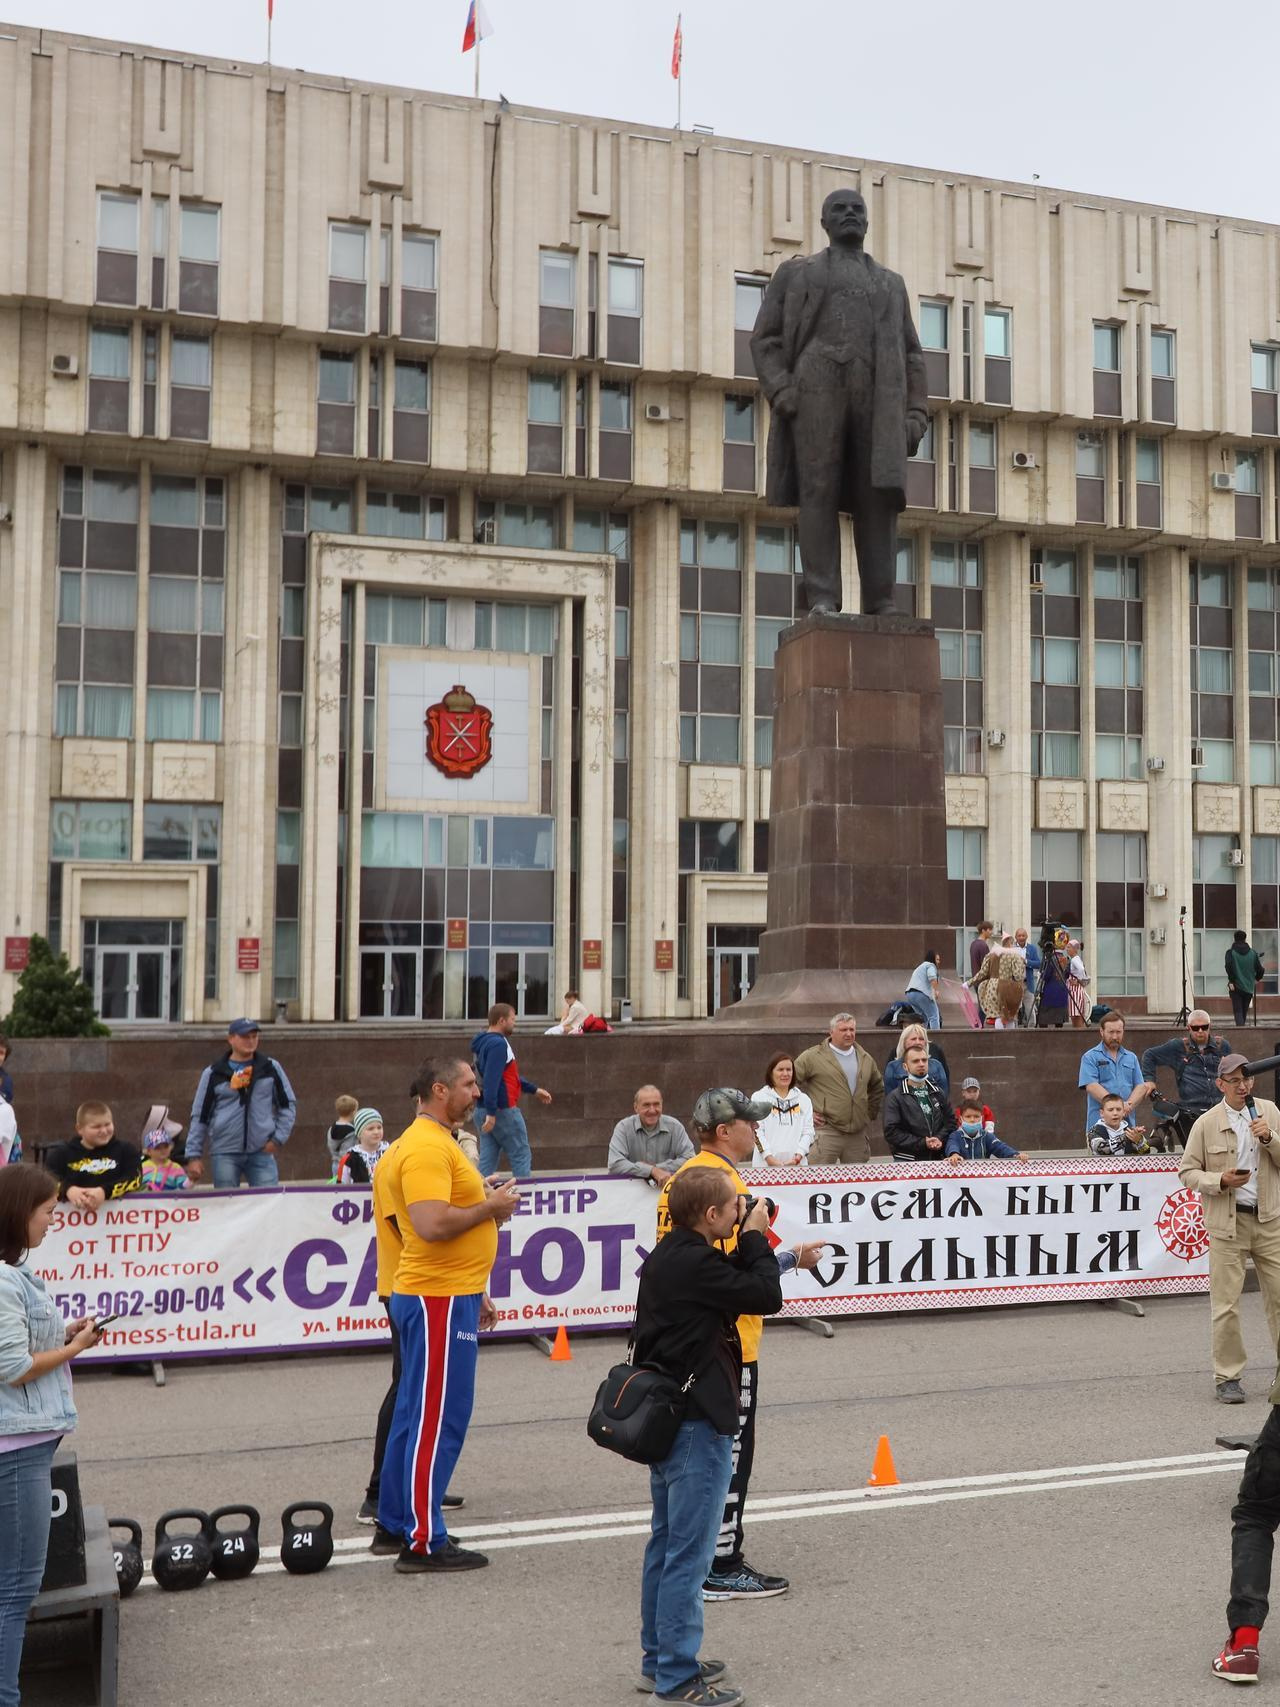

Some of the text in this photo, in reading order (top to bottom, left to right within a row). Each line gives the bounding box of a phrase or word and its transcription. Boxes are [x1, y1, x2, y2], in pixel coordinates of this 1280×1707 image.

[512, 1188, 598, 1216] ЕНТР
[1005, 1183, 1142, 1216] БЫТЬ
[52, 1207, 200, 1232] 300 метров
[68, 1232, 172, 1256] от ТГПУ
[70, 1263, 114, 1280] Л.Н.
[121, 1260, 220, 1278] Толстого
[810, 1230, 1143, 1288] СИЛЬНЫМ
[51, 1285, 225, 1320] 53-962-90-04
[98, 1319, 256, 1347] tness-tula.ru
[303, 1321, 330, 1336] ул.
[573, 1307, 602, 1316] вход
[171, 1544, 193, 1561] 32
[223, 1537, 245, 1555] 24
[292, 1532, 312, 1549] 24
